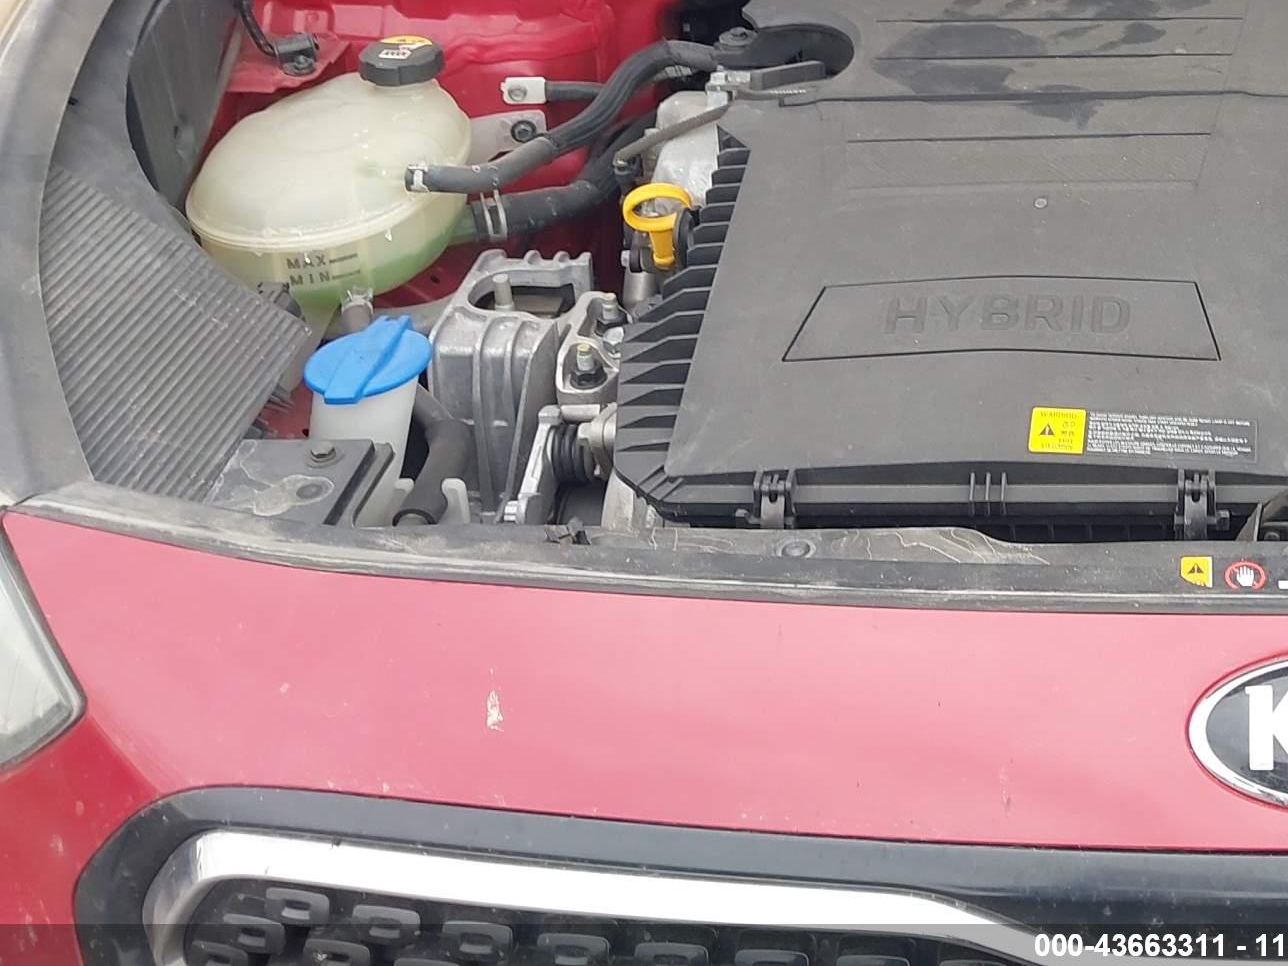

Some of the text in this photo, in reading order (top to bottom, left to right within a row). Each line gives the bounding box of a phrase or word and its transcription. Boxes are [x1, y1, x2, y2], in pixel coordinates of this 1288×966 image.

[286, 254, 326, 270] MAX
[289, 271, 330, 286] MIN
[885, 294, 1132, 334] HYBRID
